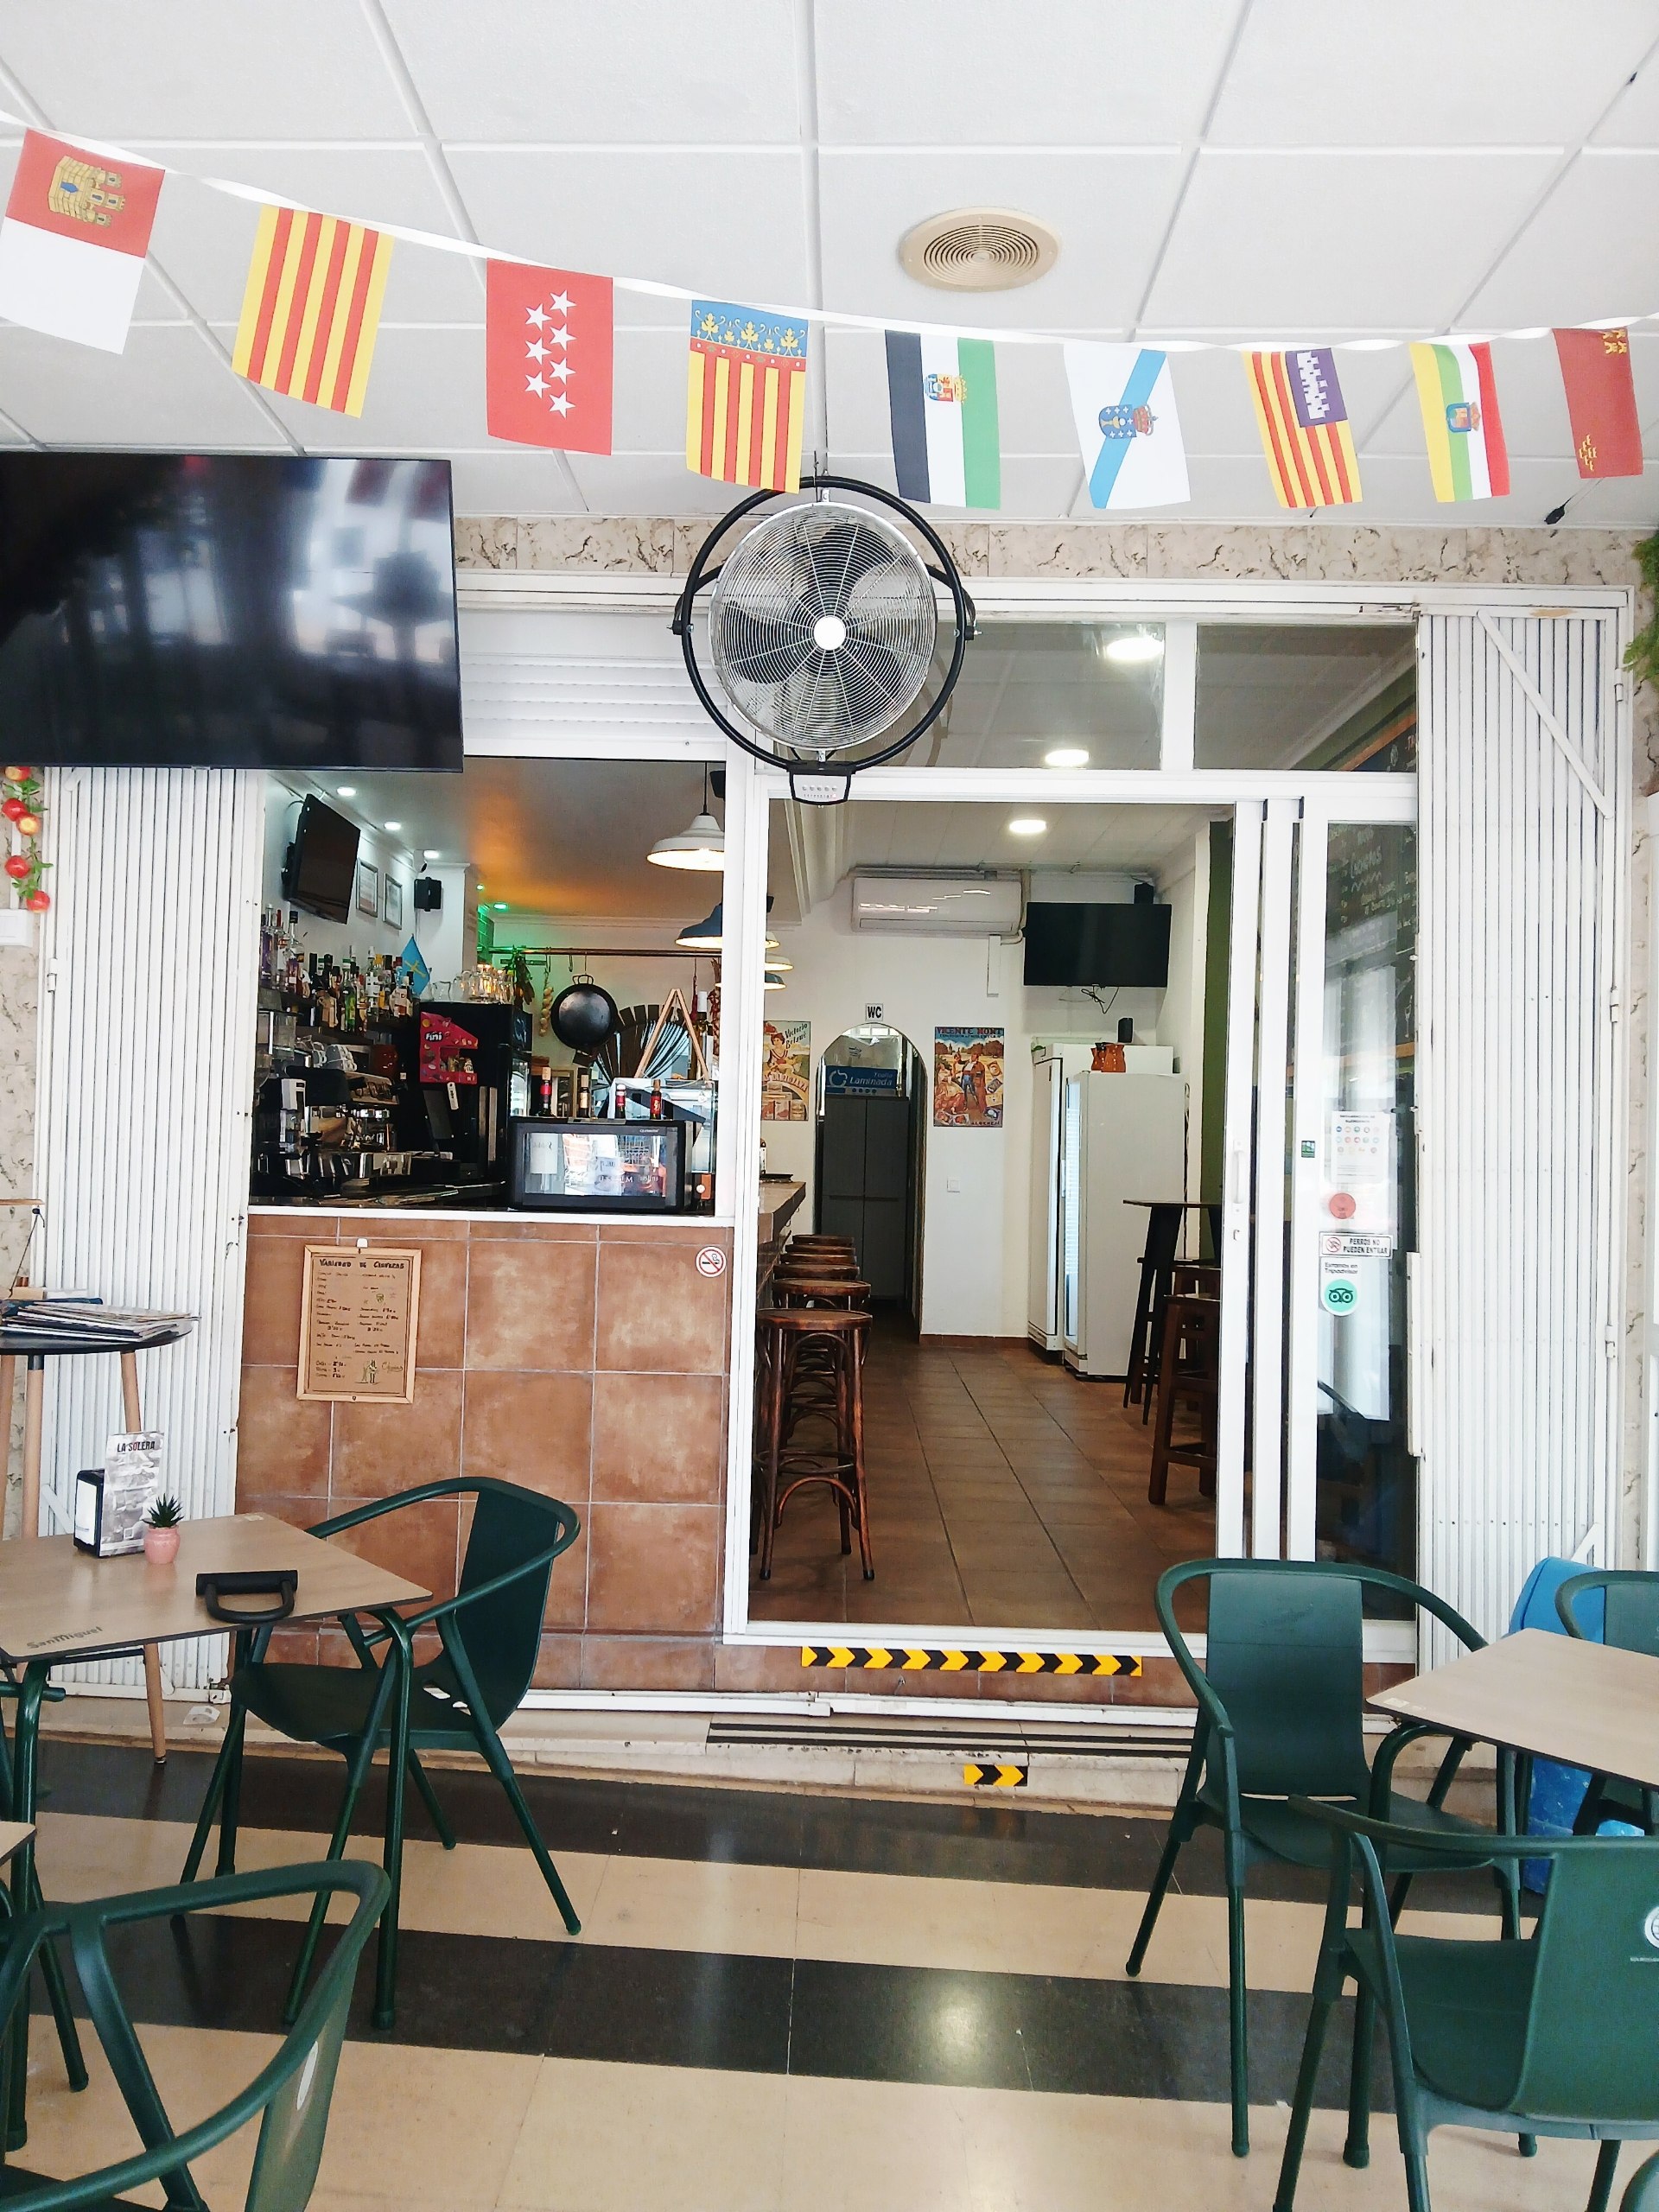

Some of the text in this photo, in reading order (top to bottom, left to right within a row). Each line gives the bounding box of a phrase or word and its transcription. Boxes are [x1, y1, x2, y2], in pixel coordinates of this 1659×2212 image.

[867, 1006, 882, 1019] WC
[849, 1077, 893, 1086] Laminada
[117, 1440, 156, 1452] LA SOLERA
